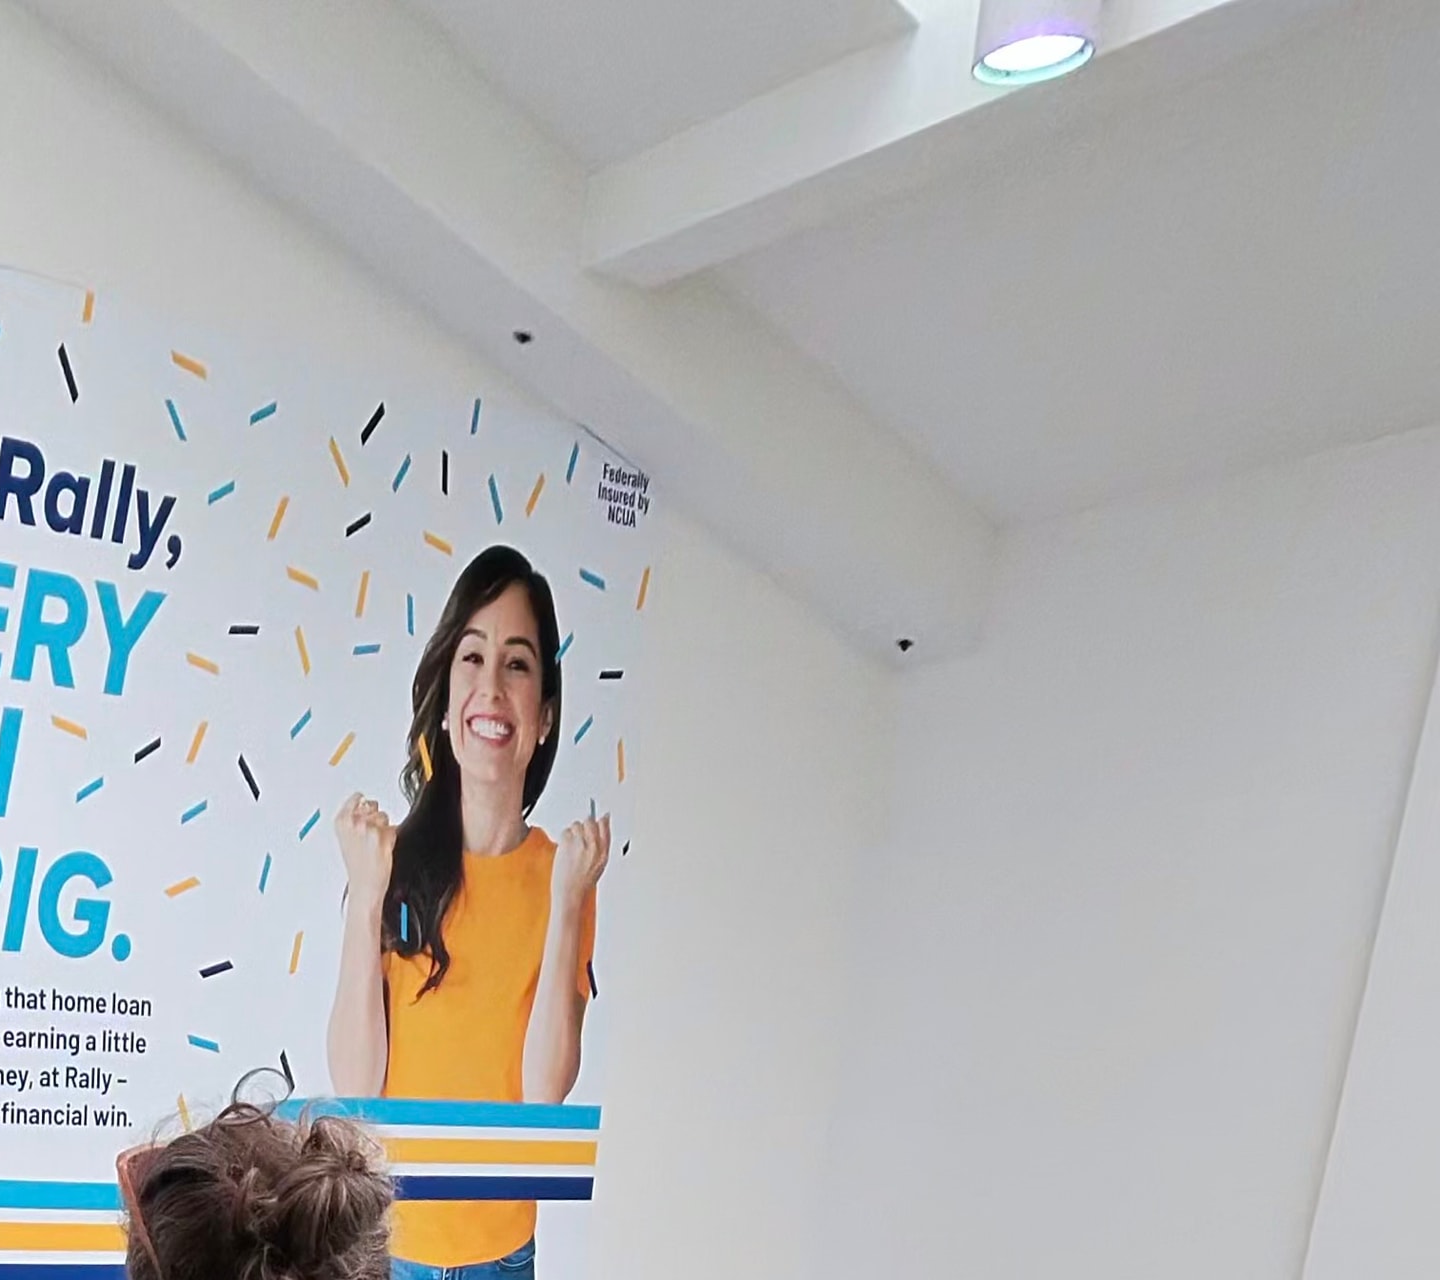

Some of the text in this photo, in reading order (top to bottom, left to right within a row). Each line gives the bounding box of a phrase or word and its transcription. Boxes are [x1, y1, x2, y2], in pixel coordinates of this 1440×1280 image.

[603, 463, 650, 494] Federally
[598, 481, 650, 515] Insured by
[608, 505, 636, 528] NCUA
[5, 986, 47, 1011] that
[52, 989, 107, 1014] home
[112, 993, 152, 1017] loan
[3, 1029, 80, 1056] earning
[85, 1036, 97, 1051] a
[102, 1030, 147, 1054] little
[39, 1067, 60, 1088] at
[65, 1066, 112, 1095] Rally
[1, 1102, 88, 1127] financial
[93, 1105, 133, 1127] win.
